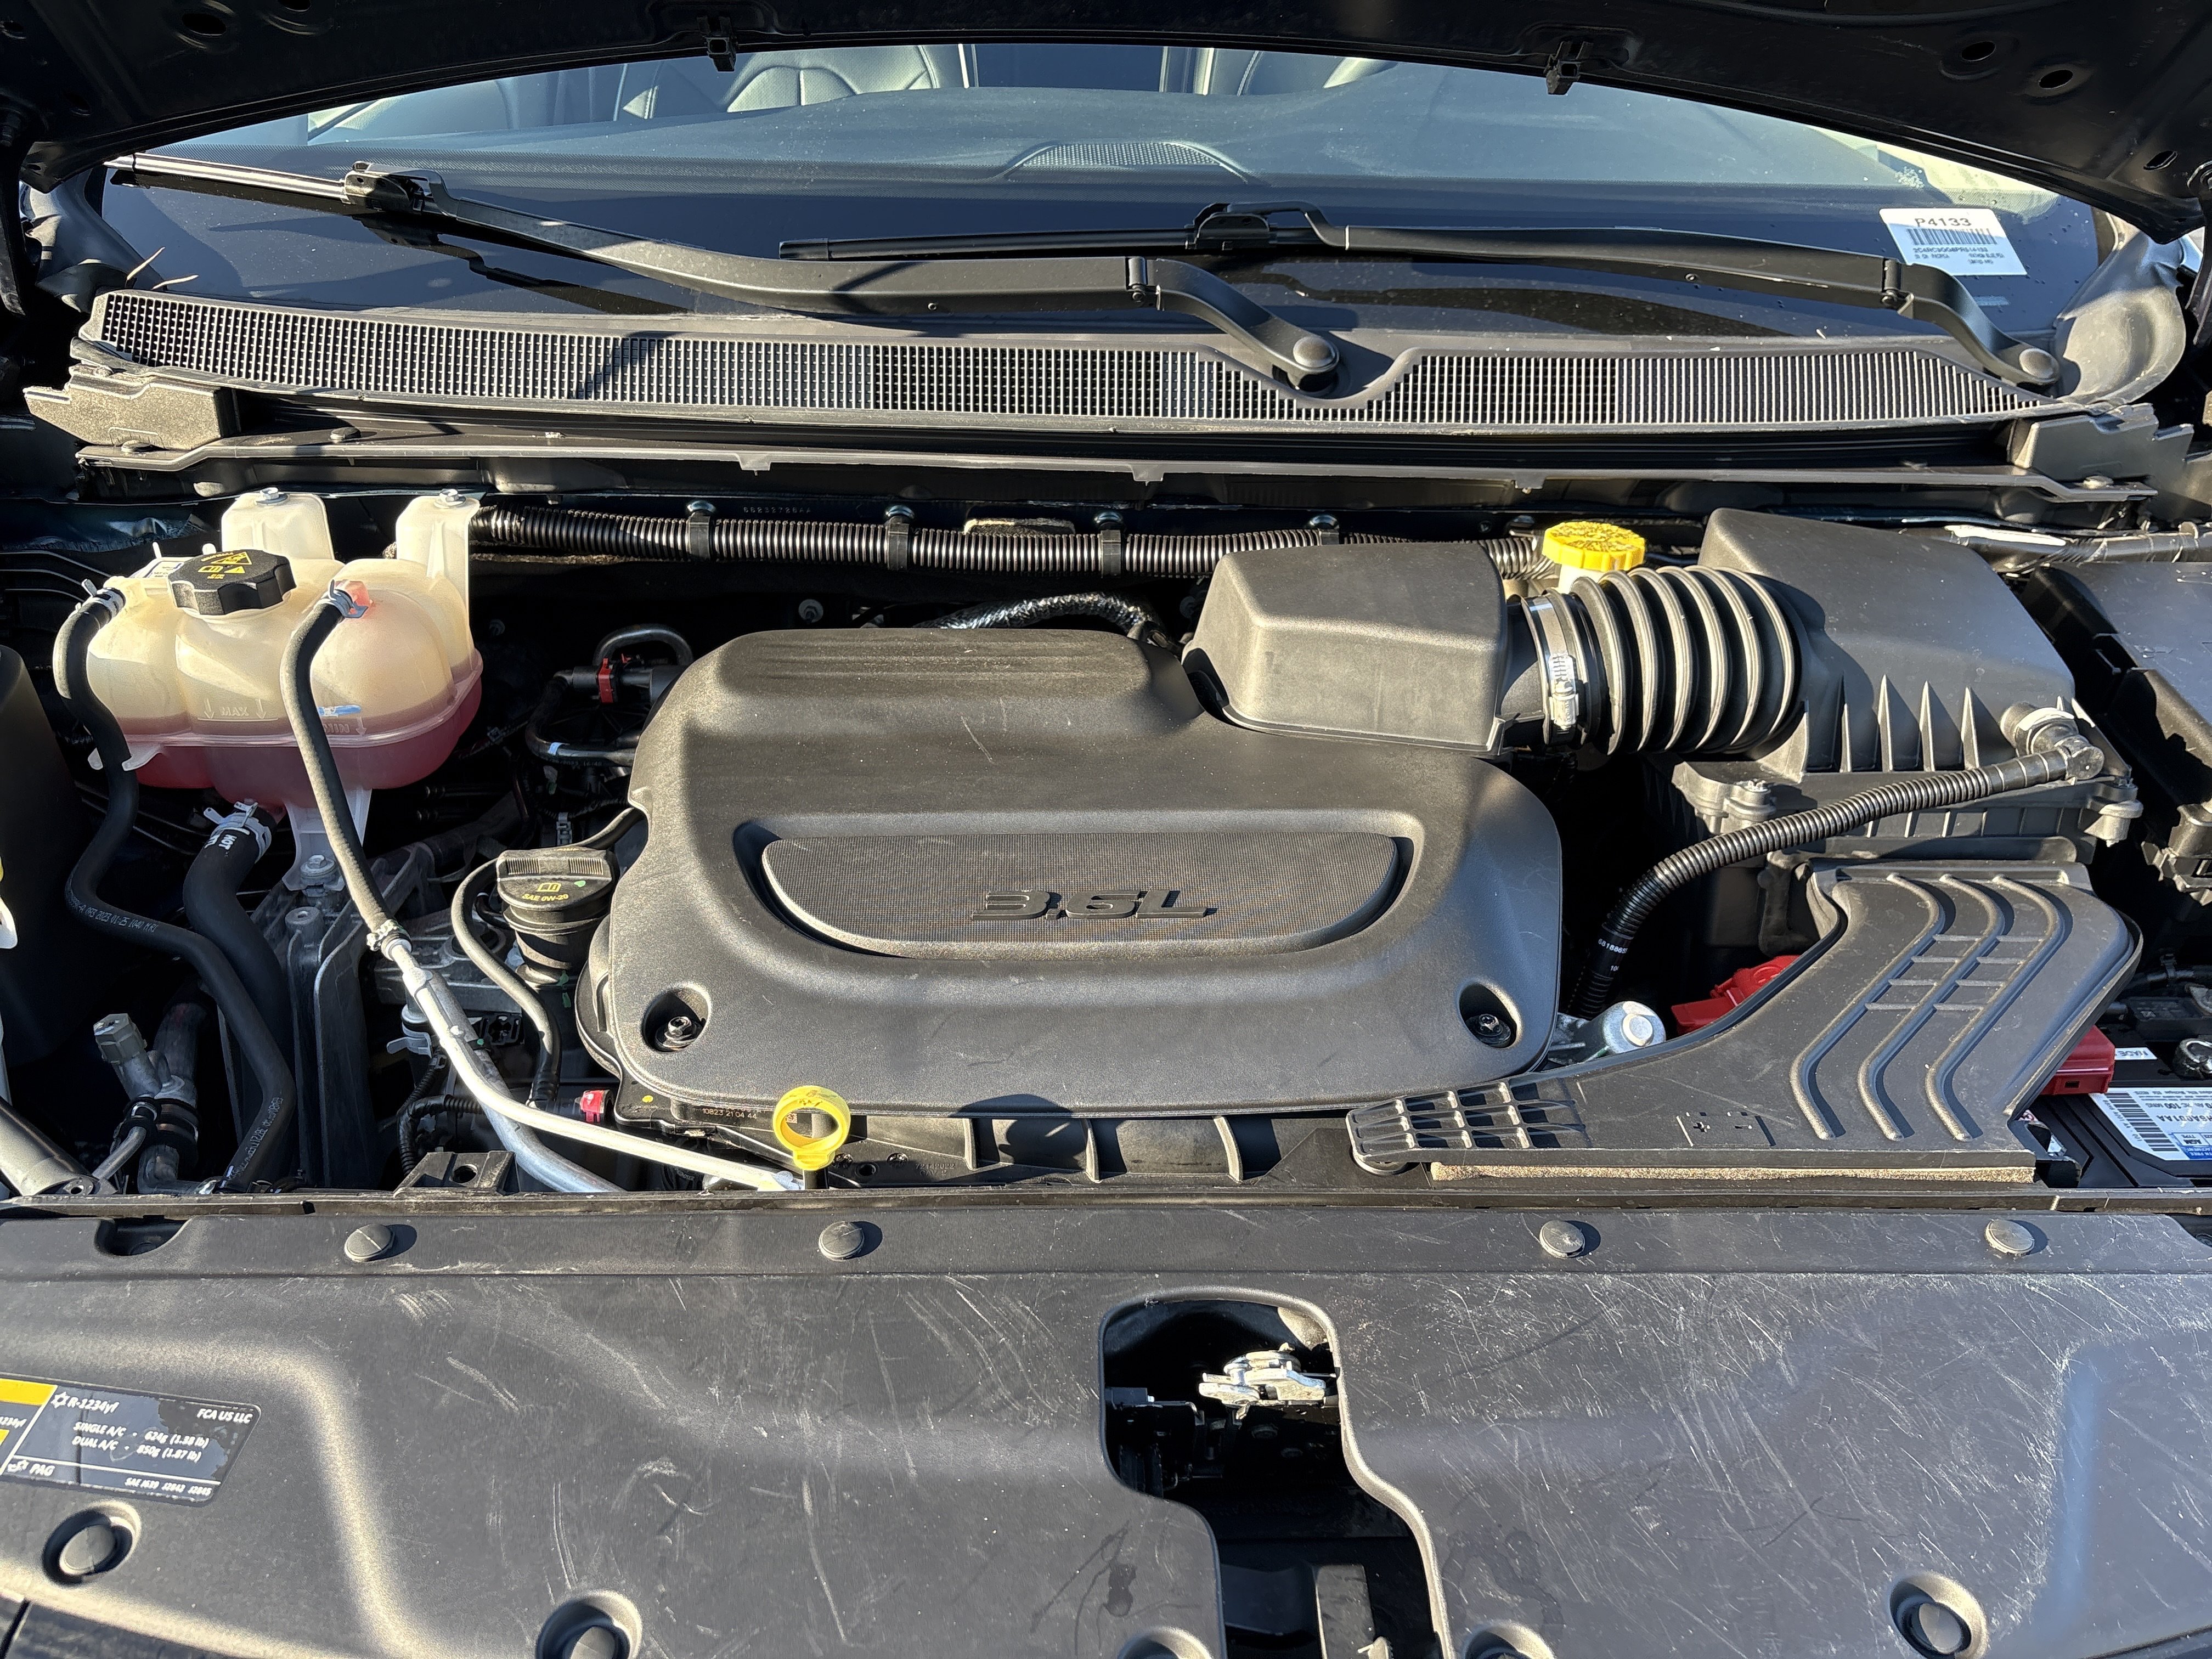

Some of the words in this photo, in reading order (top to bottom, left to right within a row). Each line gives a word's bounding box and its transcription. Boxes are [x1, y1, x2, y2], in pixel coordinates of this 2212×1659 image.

[1915, 218, 1972, 227] P4133
[220, 706, 250, 716] MAX
[218, 834, 238, 850] HOT
[522, 893, 541, 901] SAE
[541, 893, 569, 901] 0W-20
[971, 889, 1208, 921] 3.6L
[702, 1108, 724, 1116] 10823
[67, 1397, 120, 1414] R-1234yf
[196, 1408, 217, 1420] FCA
[218, 1412, 234, 1422] US
[233, 1413, 254, 1424] LLC
[73, 1421, 109, 1434] SINGLE
[106, 1426, 127, 1437] A/C
[144, 1431, 169, 1444] 624g
[72, 1436, 99, 1448] DUAL
[98, 1440, 119, 1451] A/C
[136, 1444, 161, 1458] 850g
[29, 1463, 55, 1476] PAG
[125, 1477, 142, 1487] SAE
